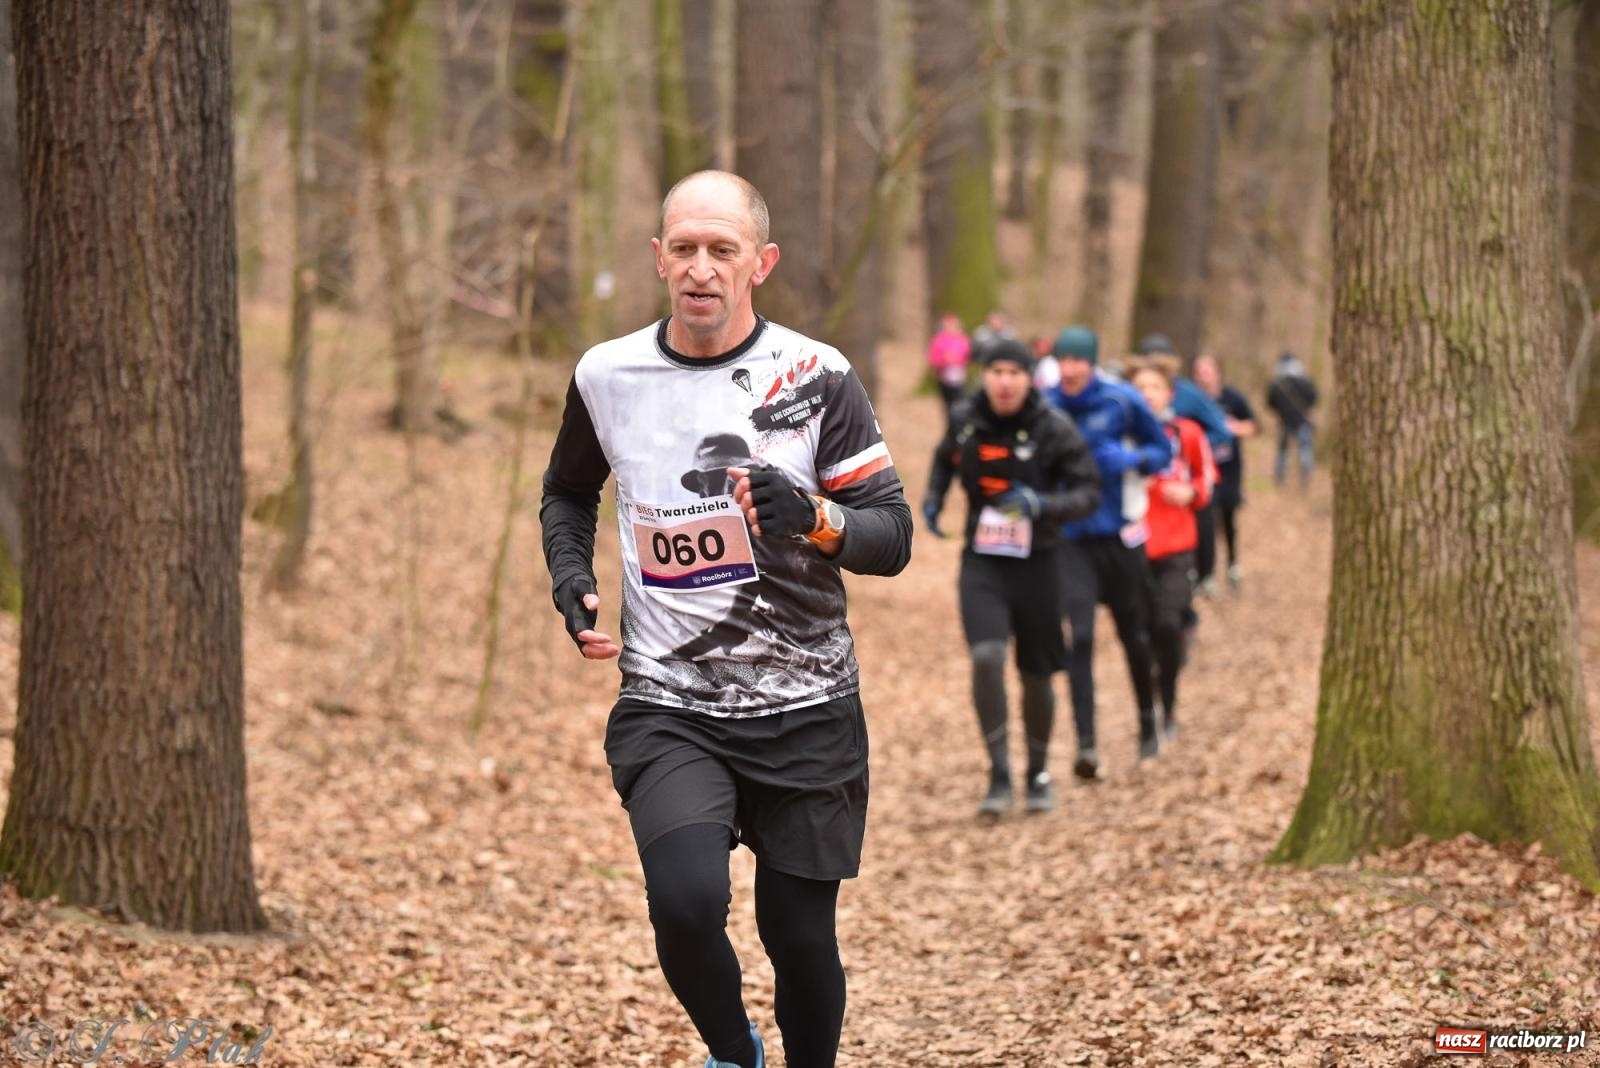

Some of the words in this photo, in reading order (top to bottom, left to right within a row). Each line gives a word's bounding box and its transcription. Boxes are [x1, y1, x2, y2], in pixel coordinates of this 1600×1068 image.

[636, 504, 654, 517] BIEG
[655, 500, 729, 518] Twardziela
[652, 529, 725, 566] 060
[701, 571, 733, 583] Racibórz
